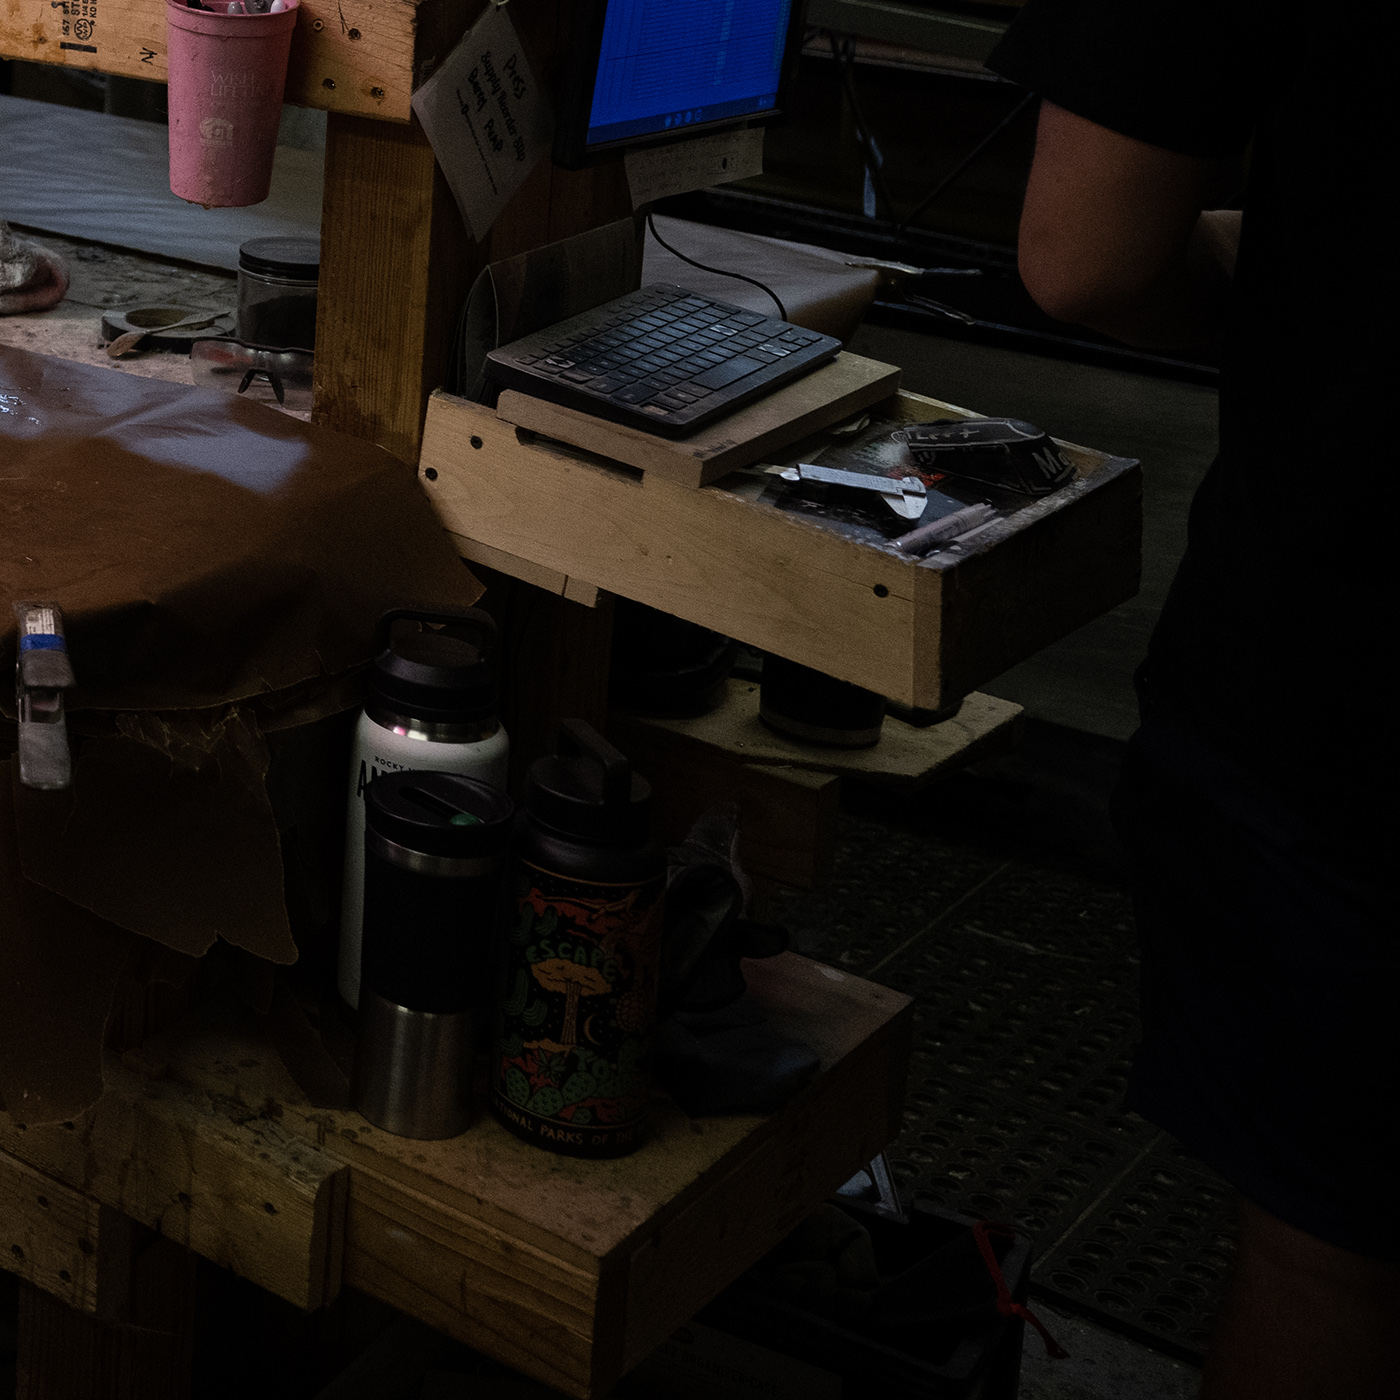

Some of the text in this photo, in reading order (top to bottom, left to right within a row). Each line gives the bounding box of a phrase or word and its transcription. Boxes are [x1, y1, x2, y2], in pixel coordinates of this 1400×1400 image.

[89, 5, 98, 19] KD
[480, 50, 504, 97] Supply
[374, 755, 405, 771] ROCKY
[525, 939, 619, 981] ESCAPE
[539, 1124, 584, 1147] PARKS
[591, 1131, 610, 1147] OF
